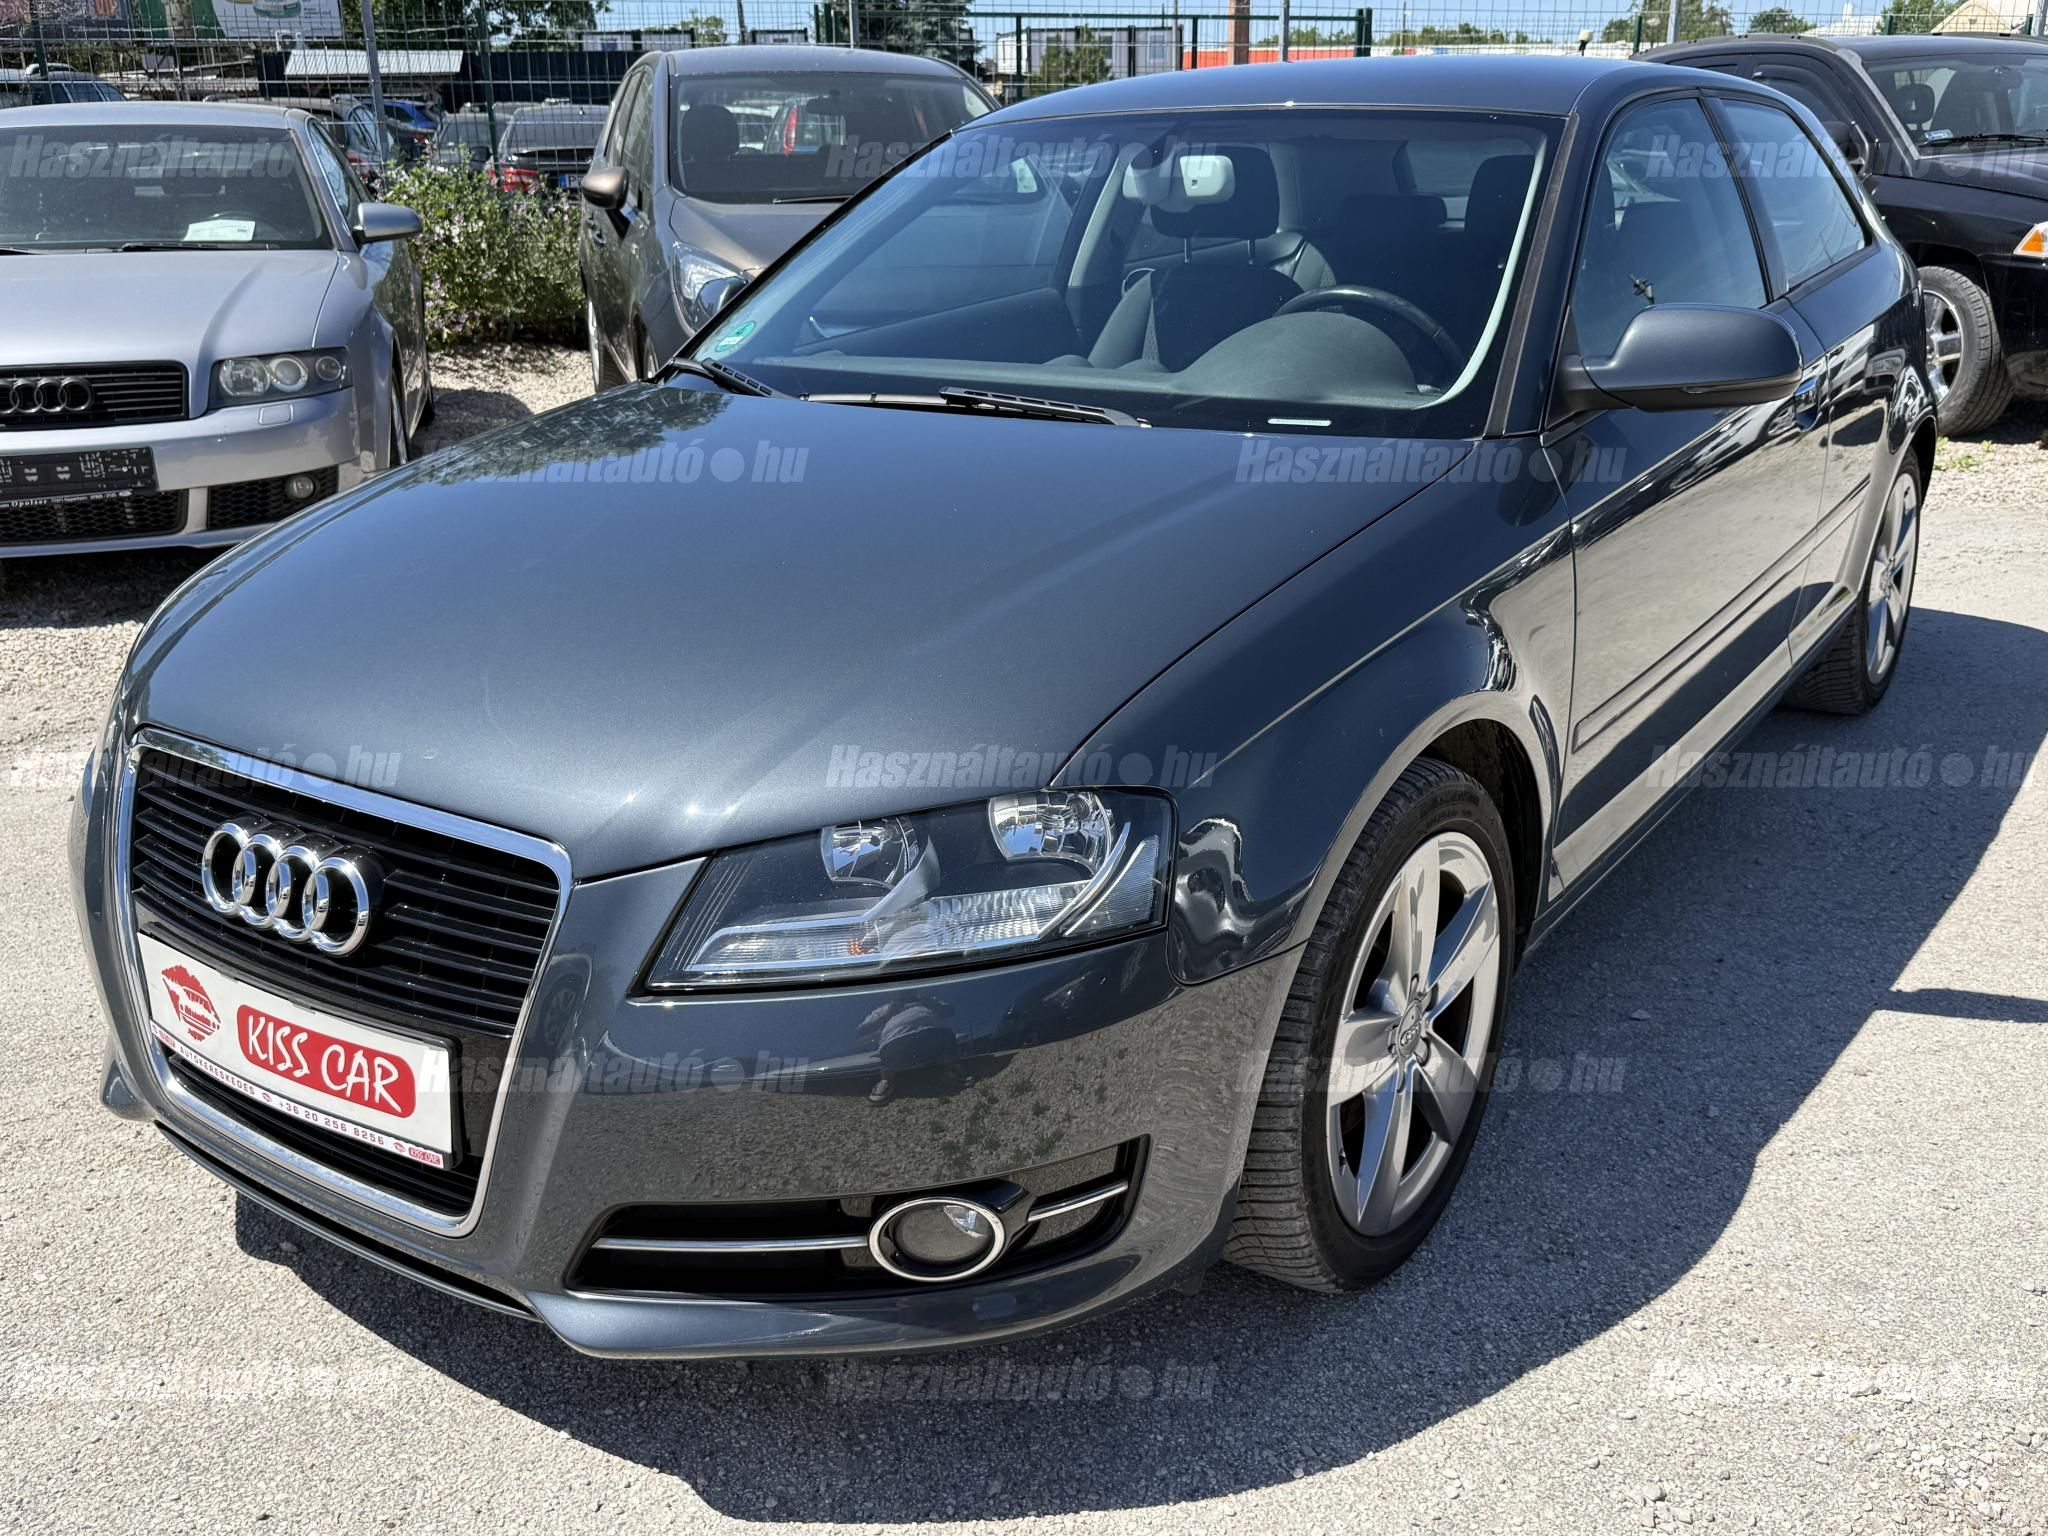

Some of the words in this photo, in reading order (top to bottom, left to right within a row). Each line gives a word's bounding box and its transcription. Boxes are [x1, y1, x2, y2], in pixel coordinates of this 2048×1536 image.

[248, 1015, 311, 1078] KISS
[321, 1044, 402, 1114] CAR
[278, 1101, 299, 1115] +36
[304, 1110, 319, 1122] 20
[324, 1117, 347, 1132] 256
[353, 1127, 385, 1146] 8256
